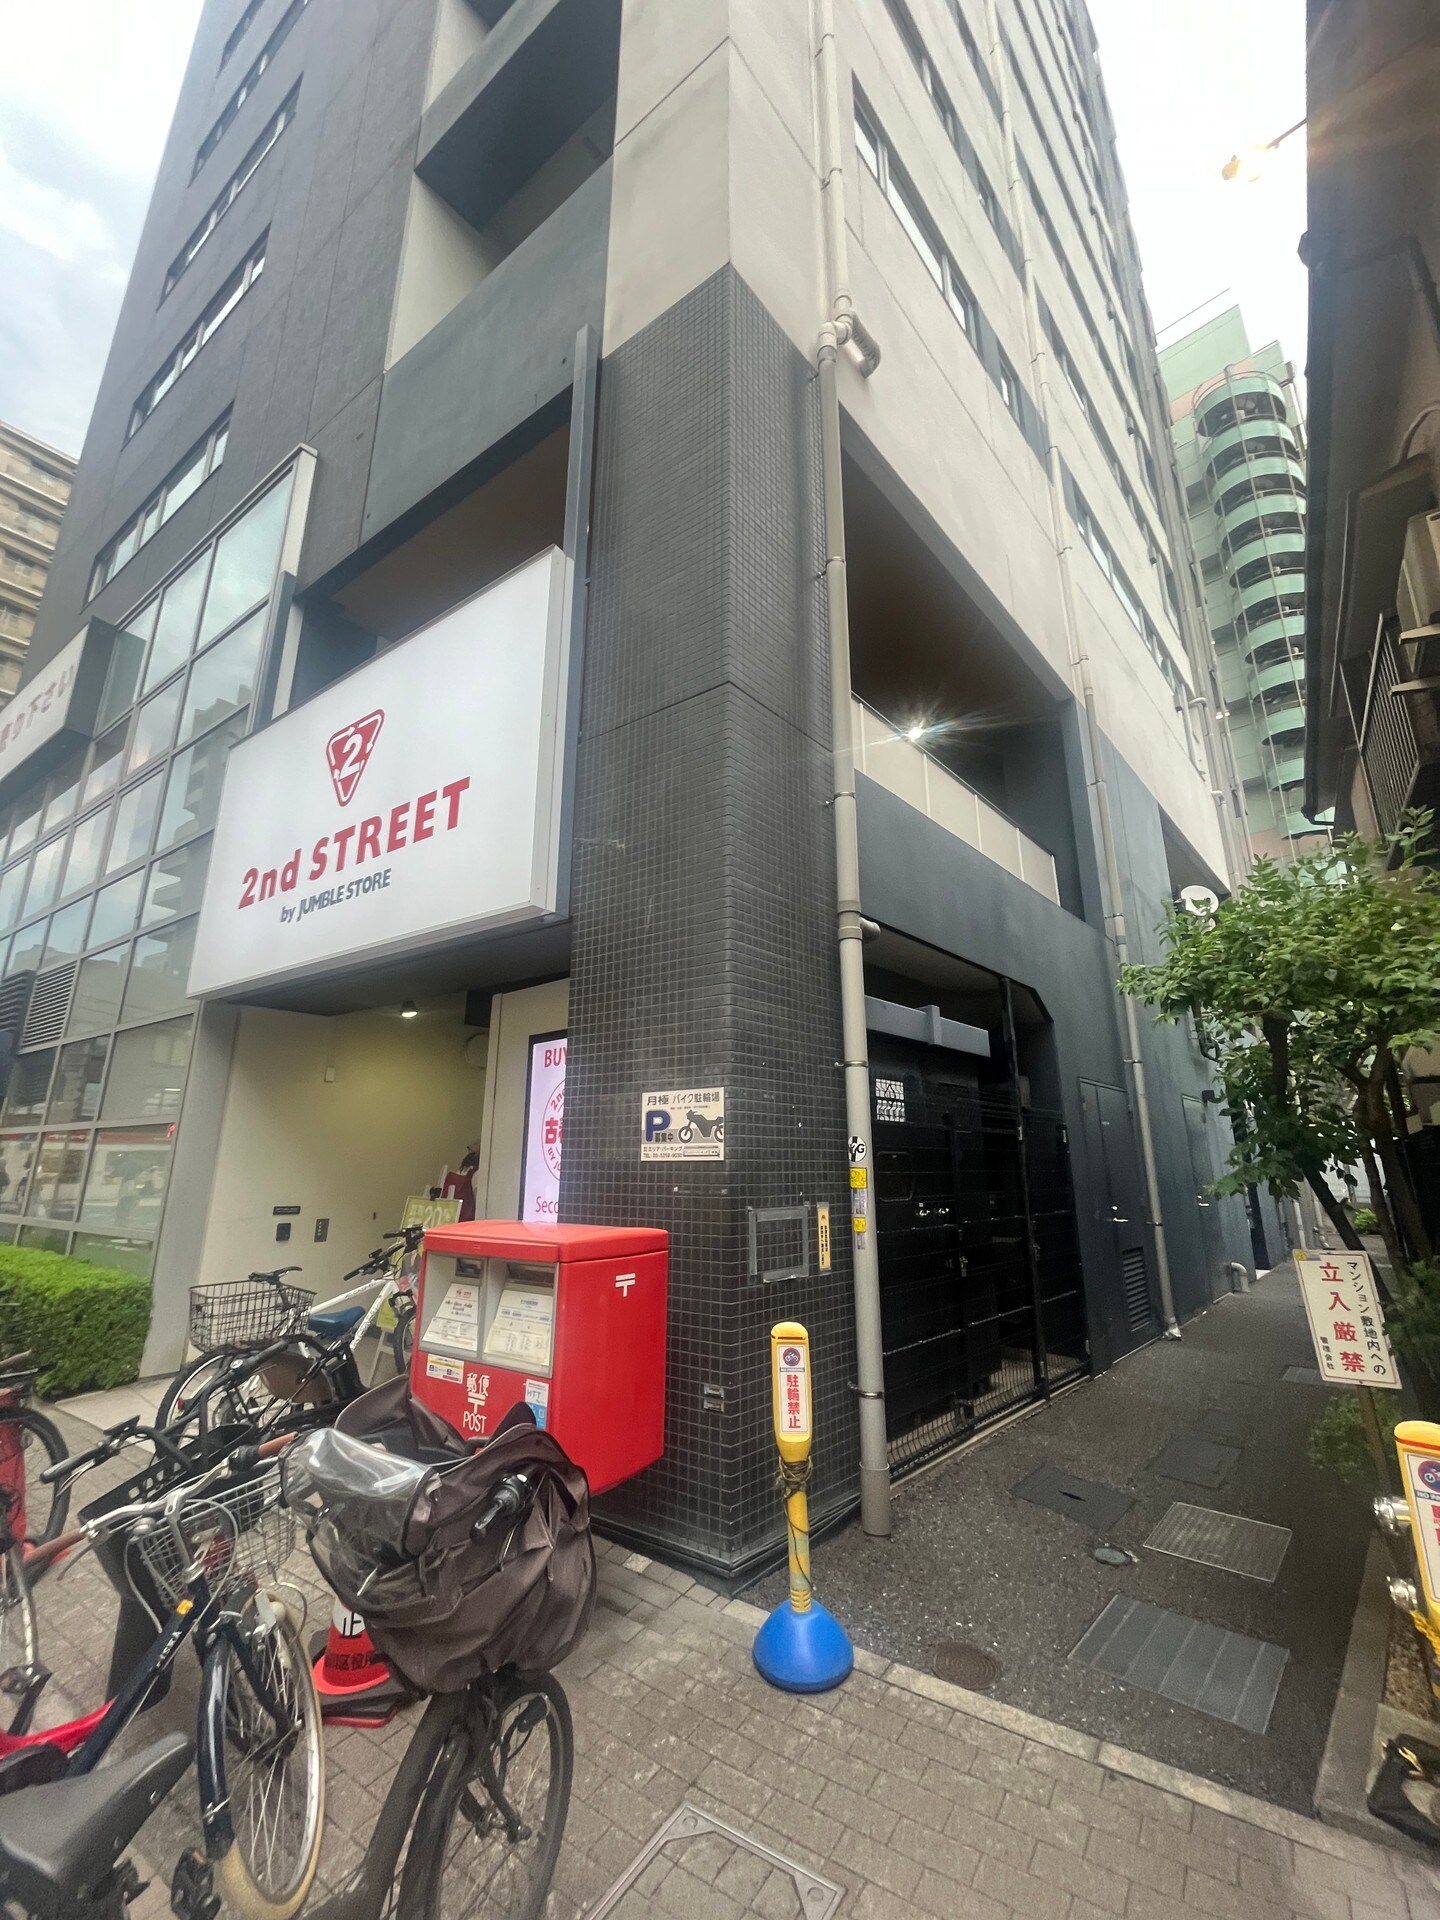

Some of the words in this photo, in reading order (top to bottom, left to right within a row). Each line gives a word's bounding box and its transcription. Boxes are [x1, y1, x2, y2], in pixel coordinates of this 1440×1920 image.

[238, 847, 302, 909] 2nd
[308, 776, 471, 881] STREET
[280, 905, 296, 923] by
[297, 884, 345, 921] JUMBLE
[346, 868, 392, 900] STORE
[646, 1110, 671, 1142] P
[647, 1094, 669, 1106] 月極
[672, 1091, 720, 1104] バイク駐輪場
[1319, 1262, 1366, 1373] 立入厳禁
[1346, 1261, 1387, 1376] マンション敷地内への
[466, 1372, 490, 1397] 郵便
[786, 1374, 801, 1429] 駐輪禁止
[462, 1410, 487, 1434] POST
